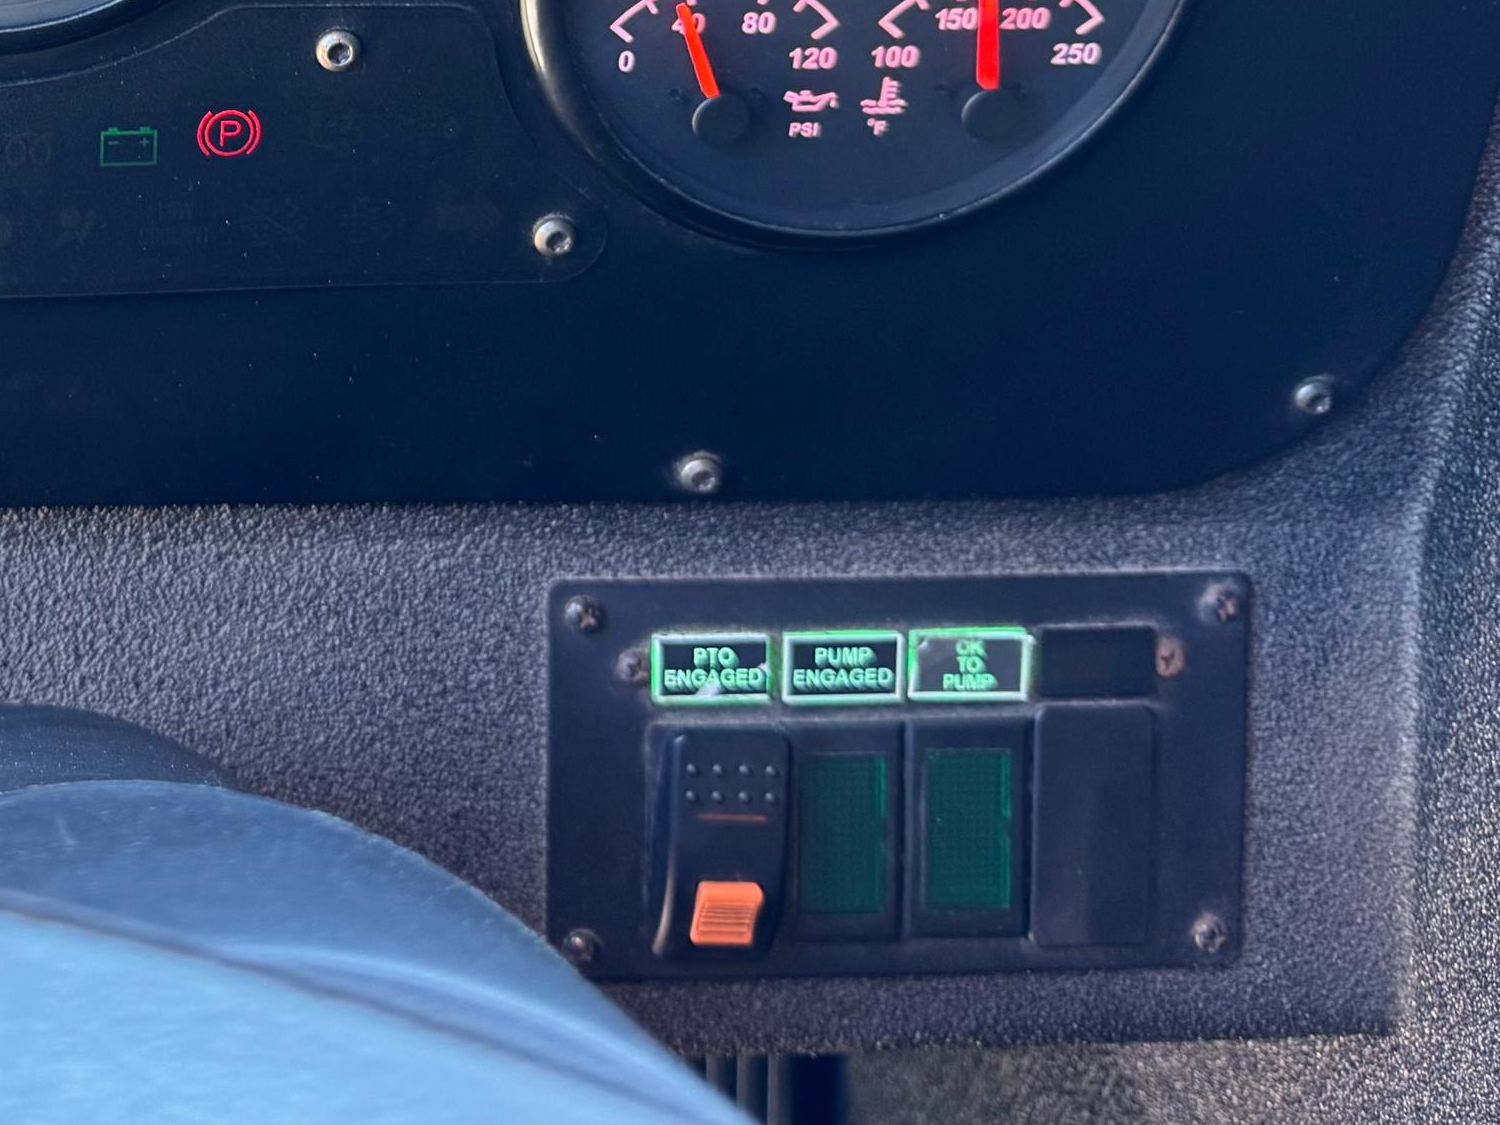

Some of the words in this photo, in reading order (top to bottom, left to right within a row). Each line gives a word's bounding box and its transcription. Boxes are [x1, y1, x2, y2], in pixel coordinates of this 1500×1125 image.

[741, 12, 776, 34] 80
[935, 7, 979, 30] 150
[999, 7, 1051, 30] 200
[617, 50, 635, 73] 0
[788, 47, 838, 69] 120
[871, 45, 920, 68] 100
[1051, 42, 1101, 65] 250
[788, 122, 821, 137] PSI
[693, 647, 736, 668] PTO
[815, 647, 875, 668] PUMP
[955, 639, 986, 655] OK
[957, 656, 985, 672] TO
[664, 668, 763, 689] ENGAGED
[793, 668, 894, 689] ENGAGED
[943, 673, 997, 691] PUMP
